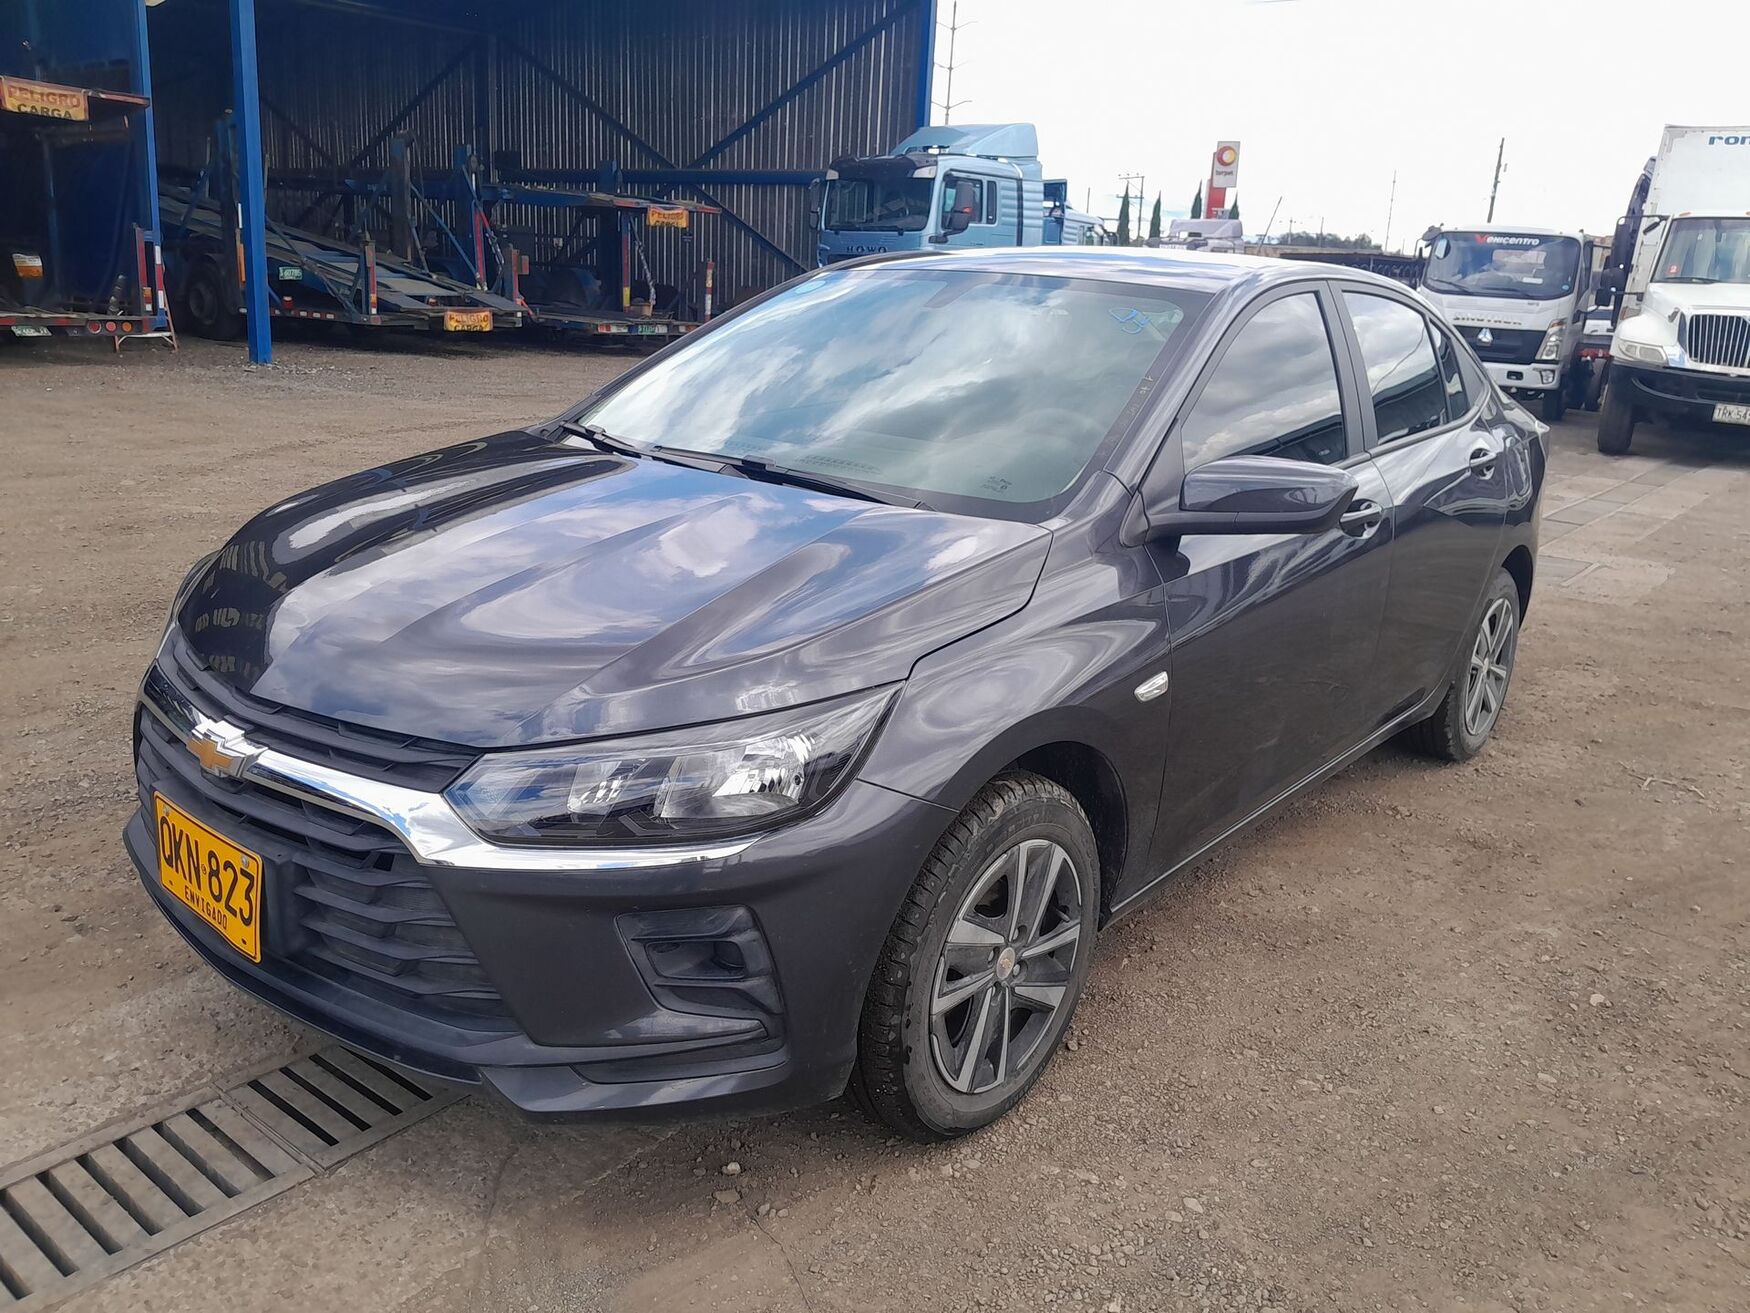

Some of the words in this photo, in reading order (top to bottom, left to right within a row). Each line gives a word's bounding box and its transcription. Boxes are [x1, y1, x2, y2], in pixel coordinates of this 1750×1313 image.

[7, 84, 81, 107] PELIGRO
[17, 103, 73, 119] CARGA
[846, 245, 887, 254] HOWO
[449, 313, 489, 323] PELIGRO
[207, 850, 255, 927] 823
[184, 885, 228, 931] ENVIGADO
